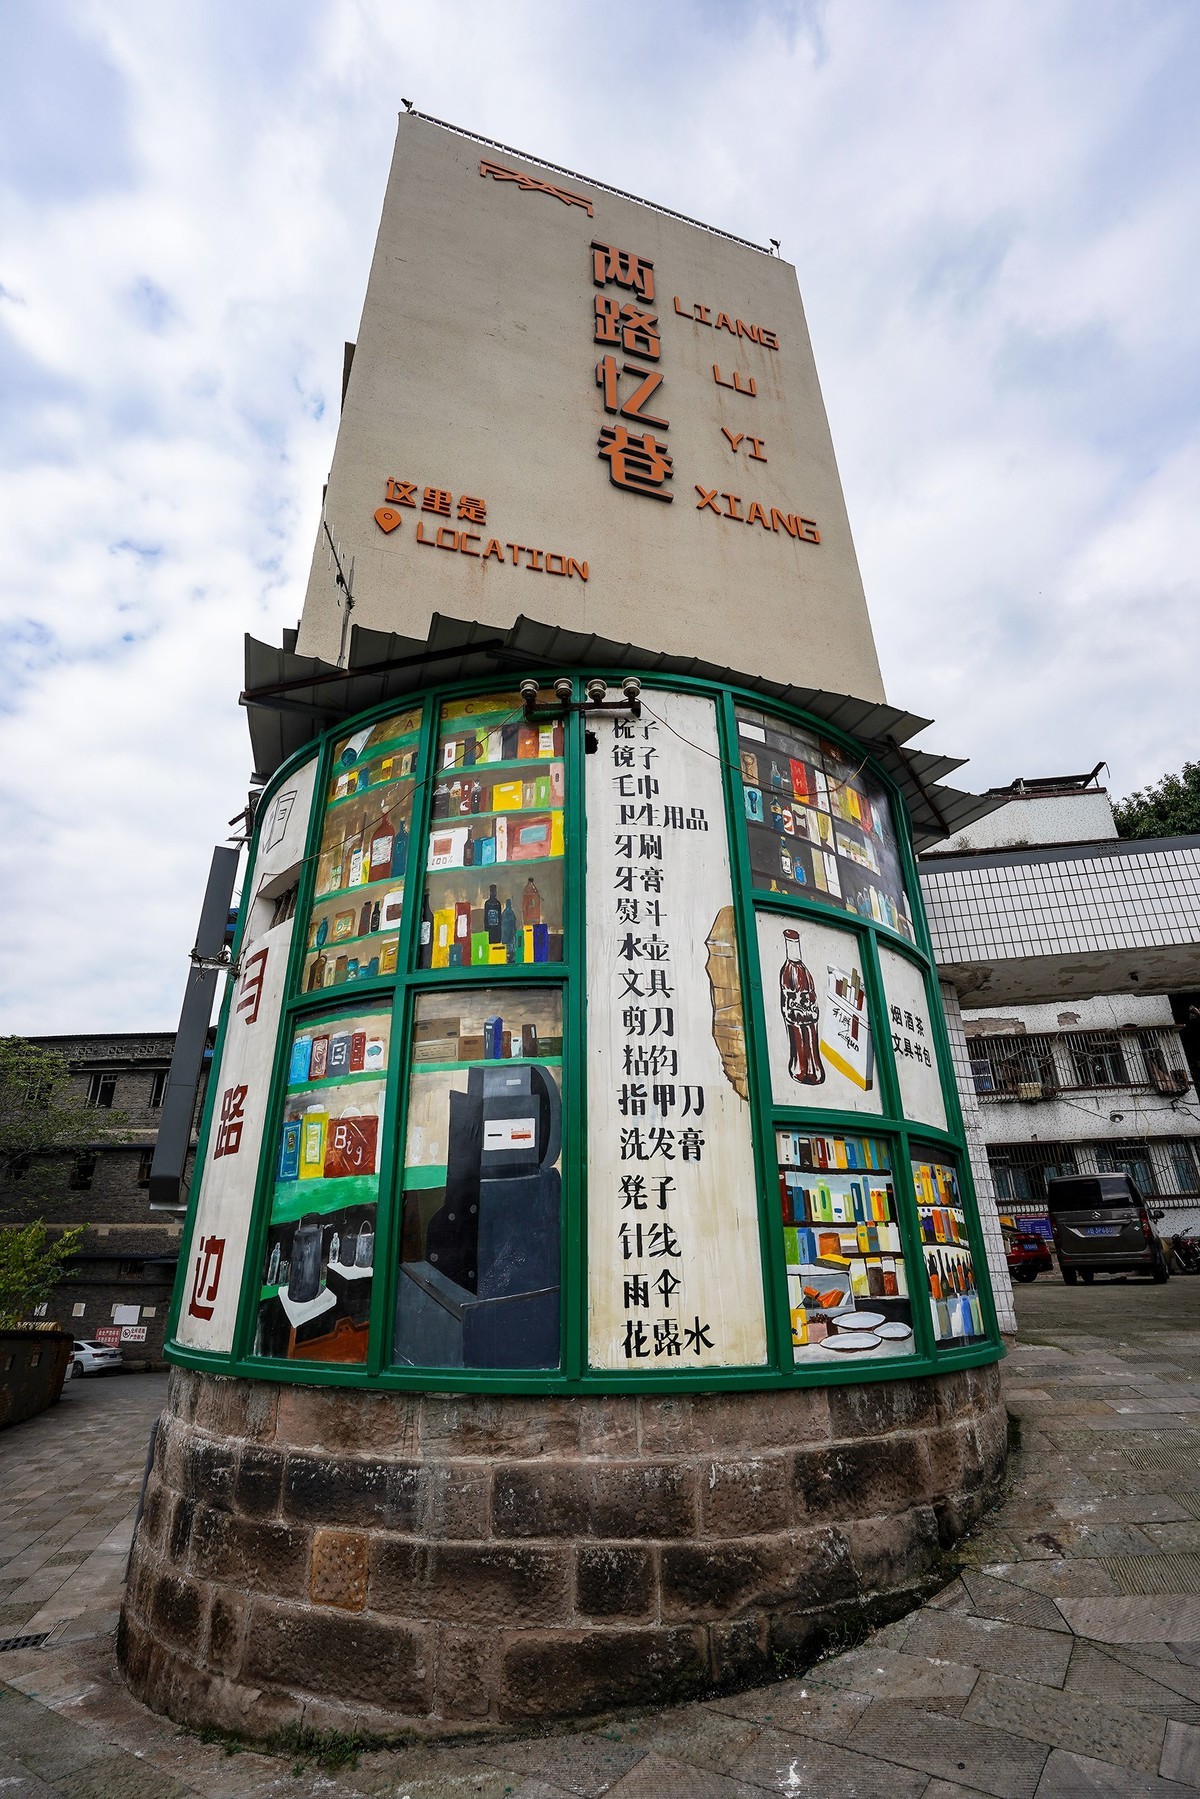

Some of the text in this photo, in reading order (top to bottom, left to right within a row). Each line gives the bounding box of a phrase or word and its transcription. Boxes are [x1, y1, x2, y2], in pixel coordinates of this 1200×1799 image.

[674, 296, 780, 350] LIANG
[590, 239, 674, 503] 两路忆巷
[713, 364, 757, 397] LU
[721, 427, 768, 463] YI
[385, 477, 487, 525] 这里是
[695, 484, 821, 545] XIANG
[416, 522, 589, 582] LOCATION
[611, 718, 659, 740] 梳子
[611, 745, 659, 769] 镜子
[611, 774, 659, 799] 毛巾
[614, 803, 709, 831] 卫生用品
[614, 834, 663, 860] 牙刷
[613, 866, 664, 893] 牙膏
[616, 898, 667, 926] 熨斗
[617, 933, 670, 961] 水壶
[618, 968, 674, 999] 文具
[621, 1006, 674, 1037] 剪刀
[622, 1045, 677, 1076] 粘钩
[891, 1033, 932, 1068] 文具书包
[616, 1083, 704, 1117] 指甲刀
[188, 947, 269, 1321] 马路边
[334, 1125, 363, 1166] Big
[620, 1127, 705, 1161] 洗发膏
[618, 1175, 677, 1210] 凳子
[618, 1223, 682, 1259] 针线
[624, 1269, 681, 1308] 雨伞
[621, 1316, 715, 1358] 花露水
